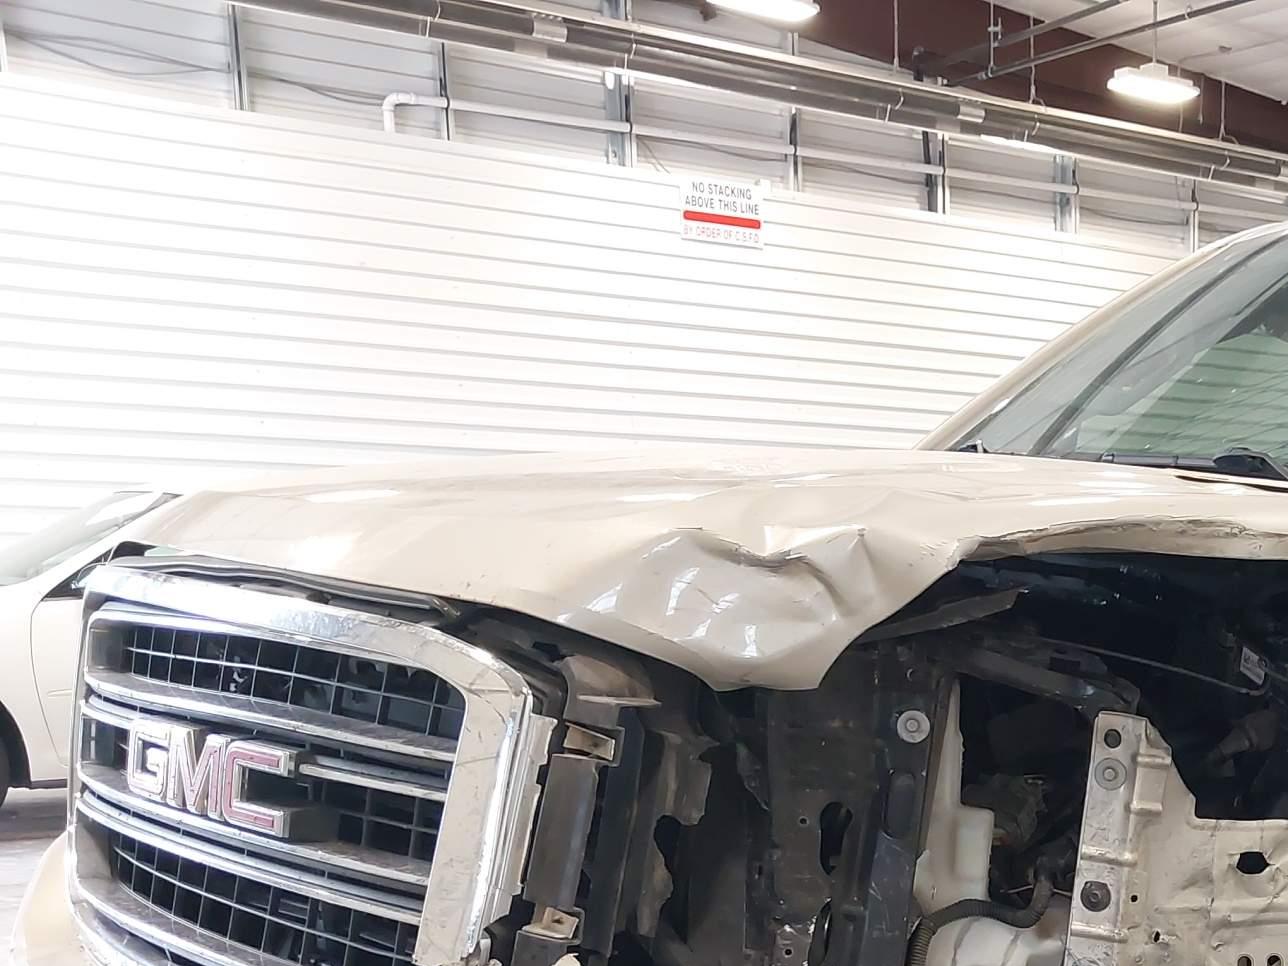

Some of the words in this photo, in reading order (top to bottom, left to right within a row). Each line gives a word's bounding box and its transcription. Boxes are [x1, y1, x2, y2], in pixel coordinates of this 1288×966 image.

[692, 181, 705, 193] NO
[708, 184, 752, 200] STACKING
[685, 195, 715, 208] ABOVE
[718, 199, 738, 213] THIS
[740, 204, 759, 215] LINE
[695, 226, 721, 238] ORDER
[128, 717, 298, 838] GMC
